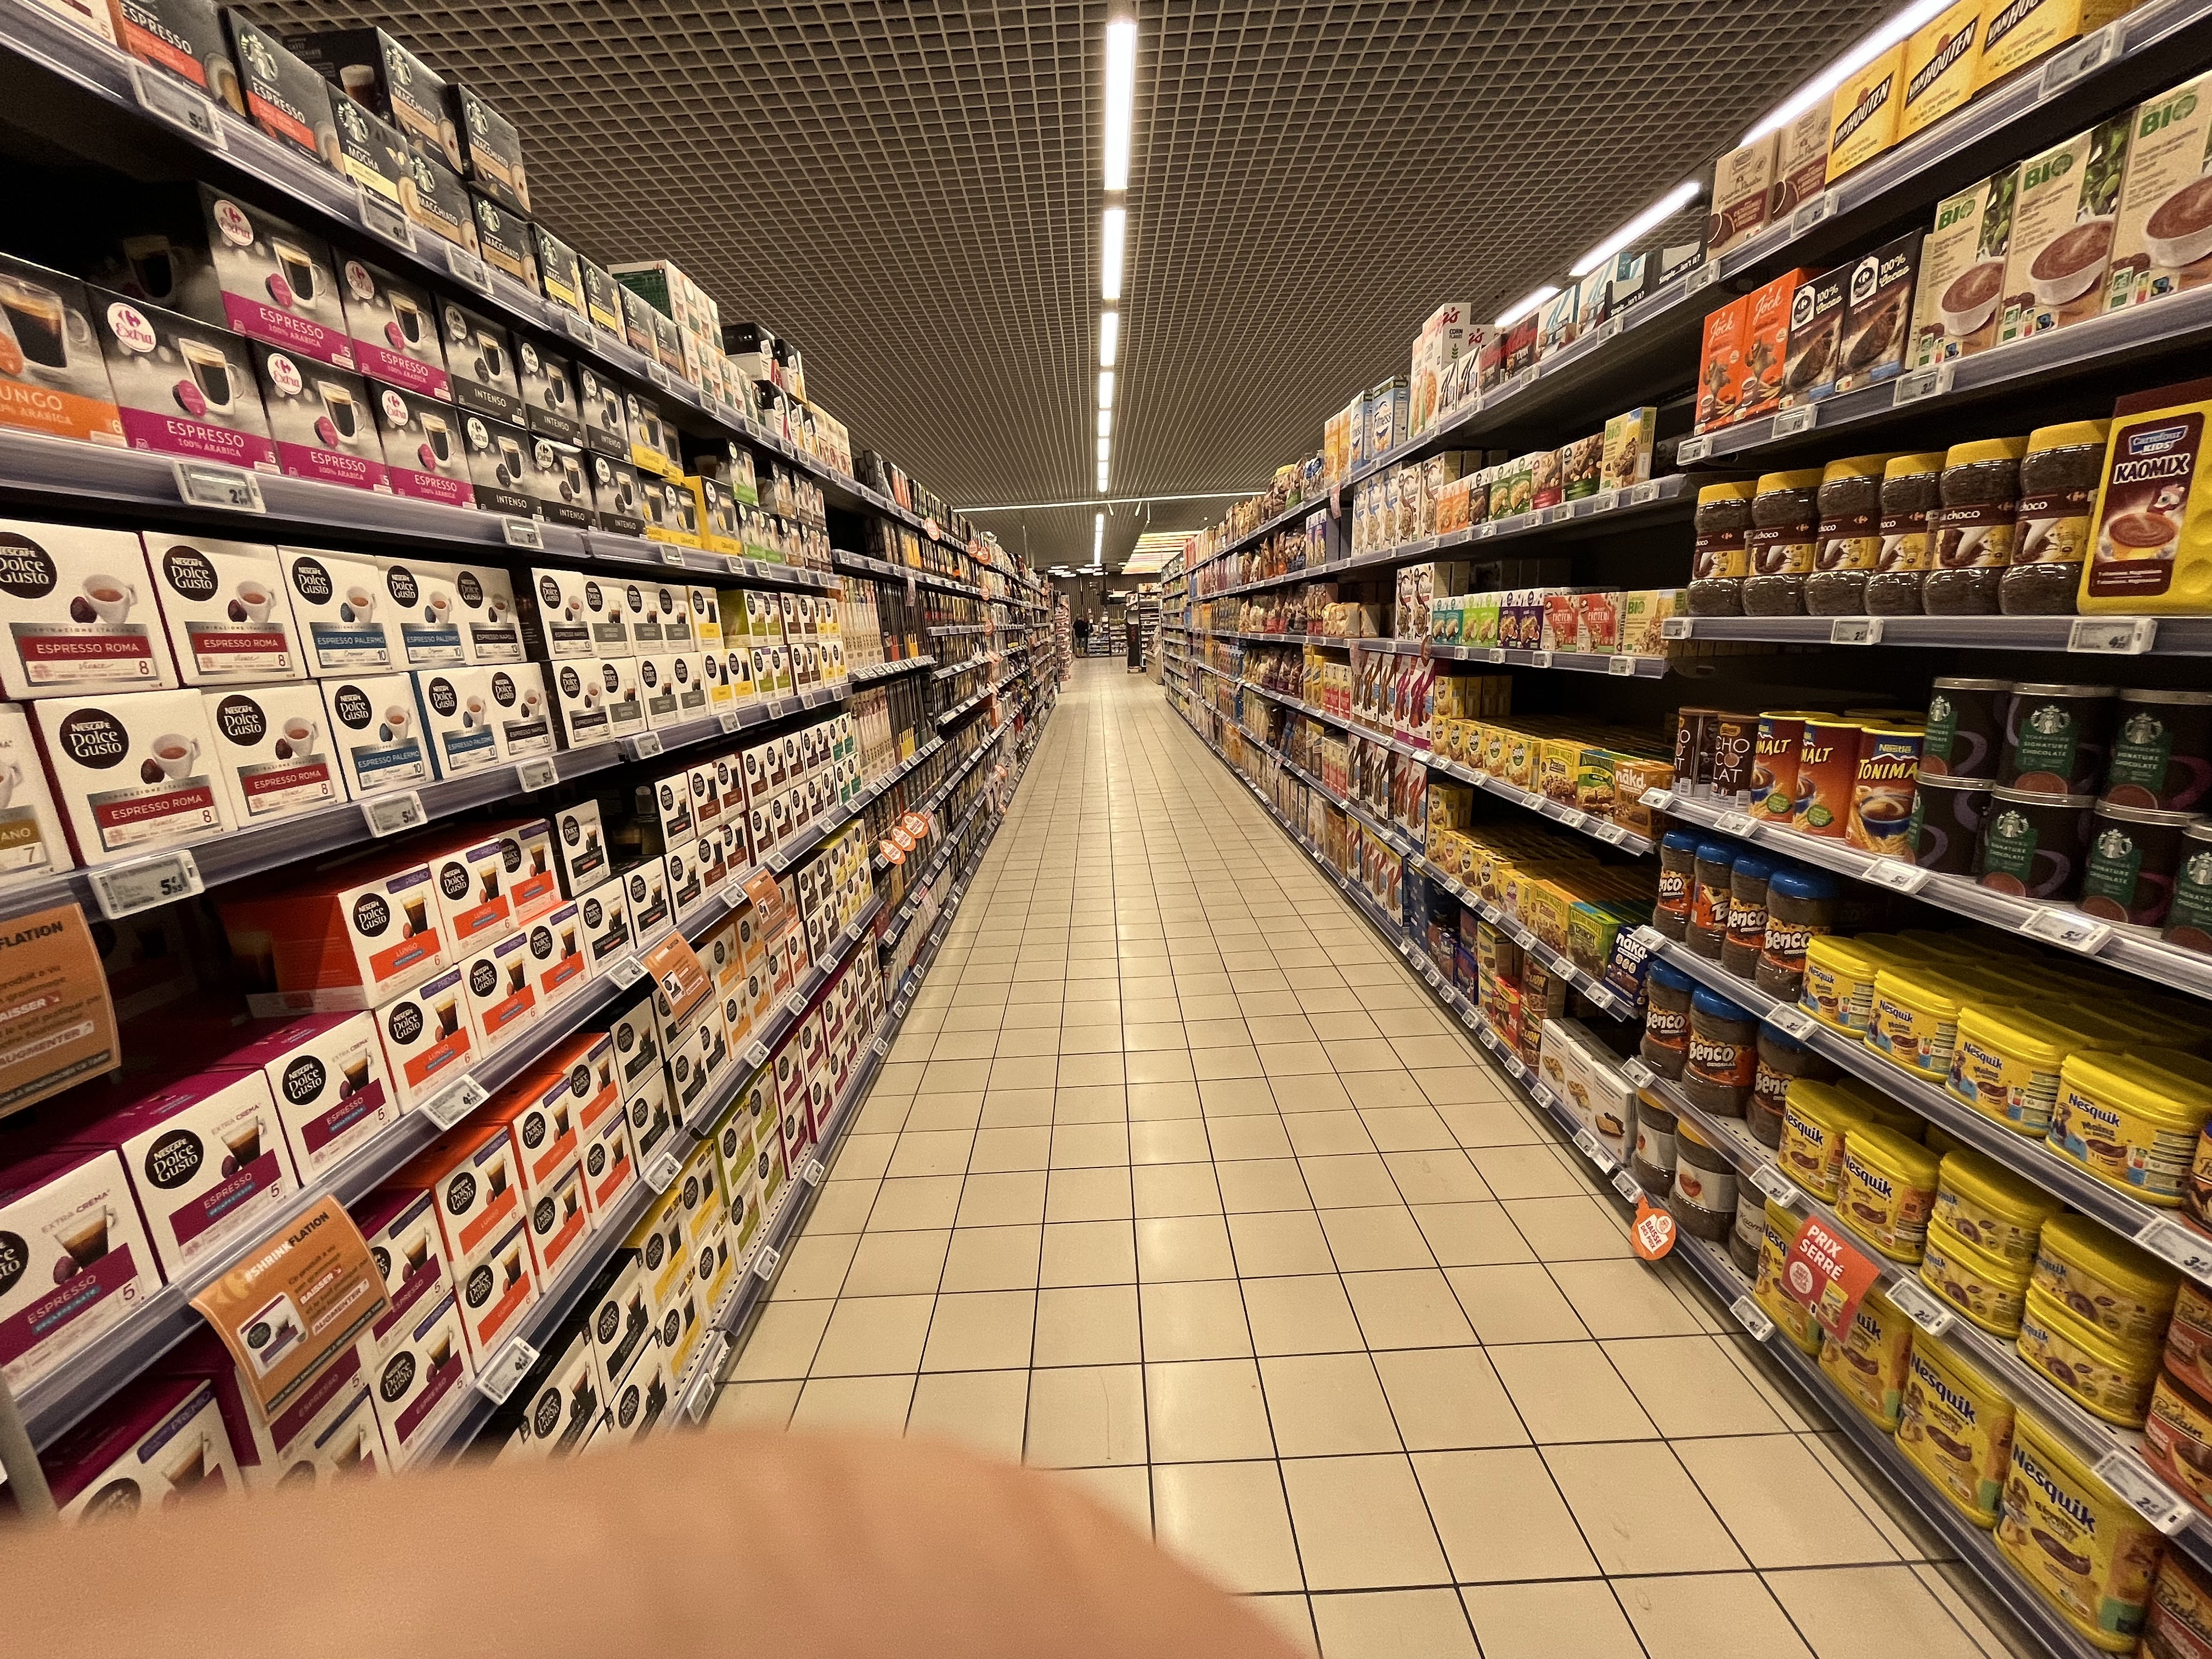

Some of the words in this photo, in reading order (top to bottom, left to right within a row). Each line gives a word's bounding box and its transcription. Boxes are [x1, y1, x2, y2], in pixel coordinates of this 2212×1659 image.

[99, 22, 111, 40] 5
[122, 5, 193, 54] ESPRESSO
[252, 82, 305, 123] ESPRESSO
[2138, 97, 2198, 139] BIO
[348, 146, 380, 172] MOCHA
[2023, 154, 2073, 192] BIO
[1937, 199, 1975, 230] BIO
[1881, 253, 1906, 274] 100%
[1816, 284, 1839, 301] 100%
[1752, 287, 1782, 325] Jock
[259, 307, 325, 340] ESPRESSO
[1708, 312, 1735, 347] Jock
[115, 324, 152, 345] Extra
[380, 351, 428, 376] ESPRESSO
[273, 370, 300, 387] Extra
[474, 388, 507, 408] INTENSO
[112, 419, 122, 435] 6
[544, 415, 569, 432] INTENSO
[166, 419, 245, 448] ESPRESSO
[2131, 427, 2187, 447] Carrefour
[204, 441, 241, 458] ARABICA
[601, 435, 621, 450] INTENSO
[2142, 441, 2174, 453] KIDS
[267, 451, 275, 464] 5
[311, 450, 366, 473] ESPRESSO
[2113, 453, 2191, 484] KAOMIX
[414, 474, 458, 493] ESPRESSO
[496, 494, 527, 509] INTENSO
[558, 508, 585, 521] INTENSO
[614, 519, 636, 531] INTENSO
[172, 566, 208, 580] Dolce
[297, 574, 327, 587] Dolce
[175, 576, 213, 590] Gusto
[301, 583, 329, 596] Gusto
[391, 579, 414, 591] Dolce
[393, 588, 416, 600] Gusto
[1588, 611, 1610, 621] PROTEIN
[1628, 601, 1646, 614] BIO
[1553, 613, 1573, 623] PROTEIN
[204, 639, 252, 650] ESPRESSO
[253, 637, 279, 647] ROMA
[317, 636, 352, 646] ESPRESSO
[353, 635, 385, 645] PALERMO
[407, 634, 435, 644] ESPRESSO
[436, 634, 460, 643] PALERMO
[36, 643, 103, 655] ESPRESSO
[105, 643, 140, 653] ROMA
[376, 649, 386, 662] 10
[454, 647, 461, 657] 10
[139, 661, 149, 675] 8
[278, 654, 286, 667] 8
[339, 700, 366, 715] Dolce
[342, 709, 369, 721] Gusto
[224, 713, 259, 727] Dolce
[227, 722, 262, 736] Gusto
[69, 730, 119, 748] Dolce
[1716, 736, 1751, 754] CHO
[2023, 741, 2068, 751] SIGNATURE
[74, 742, 122, 758] Gusto
[2022, 748, 2067, 758] CHOCOLATE
[358, 756, 391, 769] ESPRESSO
[392, 751, 420, 763] PALERMO
[413, 762, 421, 774] 10
[1713, 769, 1742, 783] LAT
[1859, 759, 1917, 781] TONIMA
[254, 772, 297, 790] ESPRESSO
[298, 769, 321, 781] ROMA
[320, 782, 329, 795] 8
[111, 800, 170, 820] ESPRESSO
[172, 794, 204, 809] ROMA
[202, 809, 212, 823] 8
[23, 847, 36, 864] 7
[443, 874, 465, 888] Dolce
[445, 881, 467, 893] Gusto
[358, 907, 384, 924] Dolce
[361, 916, 387, 930] Gusto
[435, 955, 441, 966] 6
[473, 971, 494, 985] Dolce
[1530, 974, 1545, 987] LION
[1808, 964, 1835, 985] Nesquik
[475, 978, 495, 991] Gusto
[1880, 1000, 1913, 1024] Nesquik
[393, 1014, 419, 1034] Dolce
[1646, 1012, 1685, 1030] Benco
[395, 1022, 420, 1038] Gusto
[1525, 1030, 1541, 1043] LION
[464, 1052, 471, 1064] 6
[1690, 1042, 1736, 1062] Benco
[1964, 1041, 2003, 1071] Nesquik
[289, 1069, 319, 1091] Dolce
[291, 1076, 323, 1099] Gusto
[326, 1097, 364, 1125] ESPRESSO
[378, 1108, 385, 1121] 5
[2069, 1093, 2120, 1128] Nesquik
[153, 1144, 198, 1176] Dolce
[156, 1154, 198, 1182] Gusto
[1844, 1152, 1893, 1198] Nesquik
[204, 1172, 253, 1209] ESPRESSO
[270, 1184, 280, 1198] 5
[1645, 1220, 1662, 1245] BAISSE
[1646, 1236, 1655, 1250] PRIX
[1807, 1224, 1843, 1259] PRIX
[1799, 1239, 1844, 1281] SERRÉ
[26, 1274, 97, 1324] ESPRESSO
[122, 1284, 136, 1301] 5
[457, 1376, 465, 1389] 5
[1911, 1352, 1975, 1424] Nesquik
[2013, 1444, 2096, 1534] Nesquik
